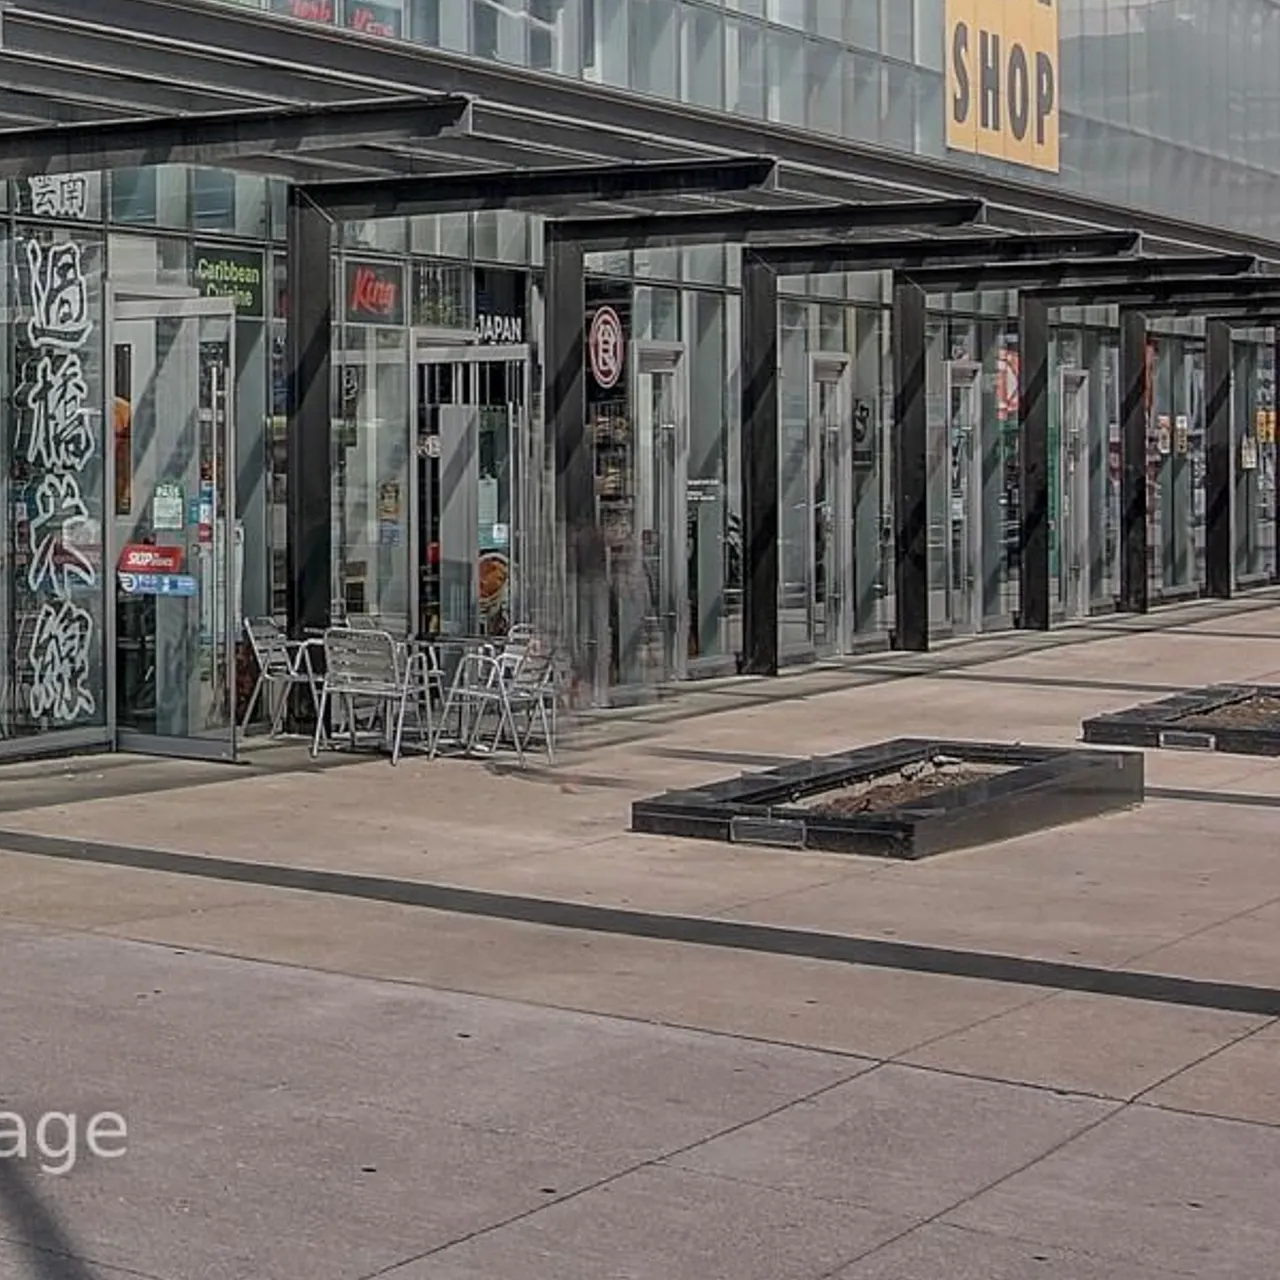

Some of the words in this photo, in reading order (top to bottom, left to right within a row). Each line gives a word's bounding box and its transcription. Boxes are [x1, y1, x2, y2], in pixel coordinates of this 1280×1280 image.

[953, 21, 1054, 146] SHOP
[198, 258, 260, 284] Caribbean
[476, 315, 523, 342] JAPAN
